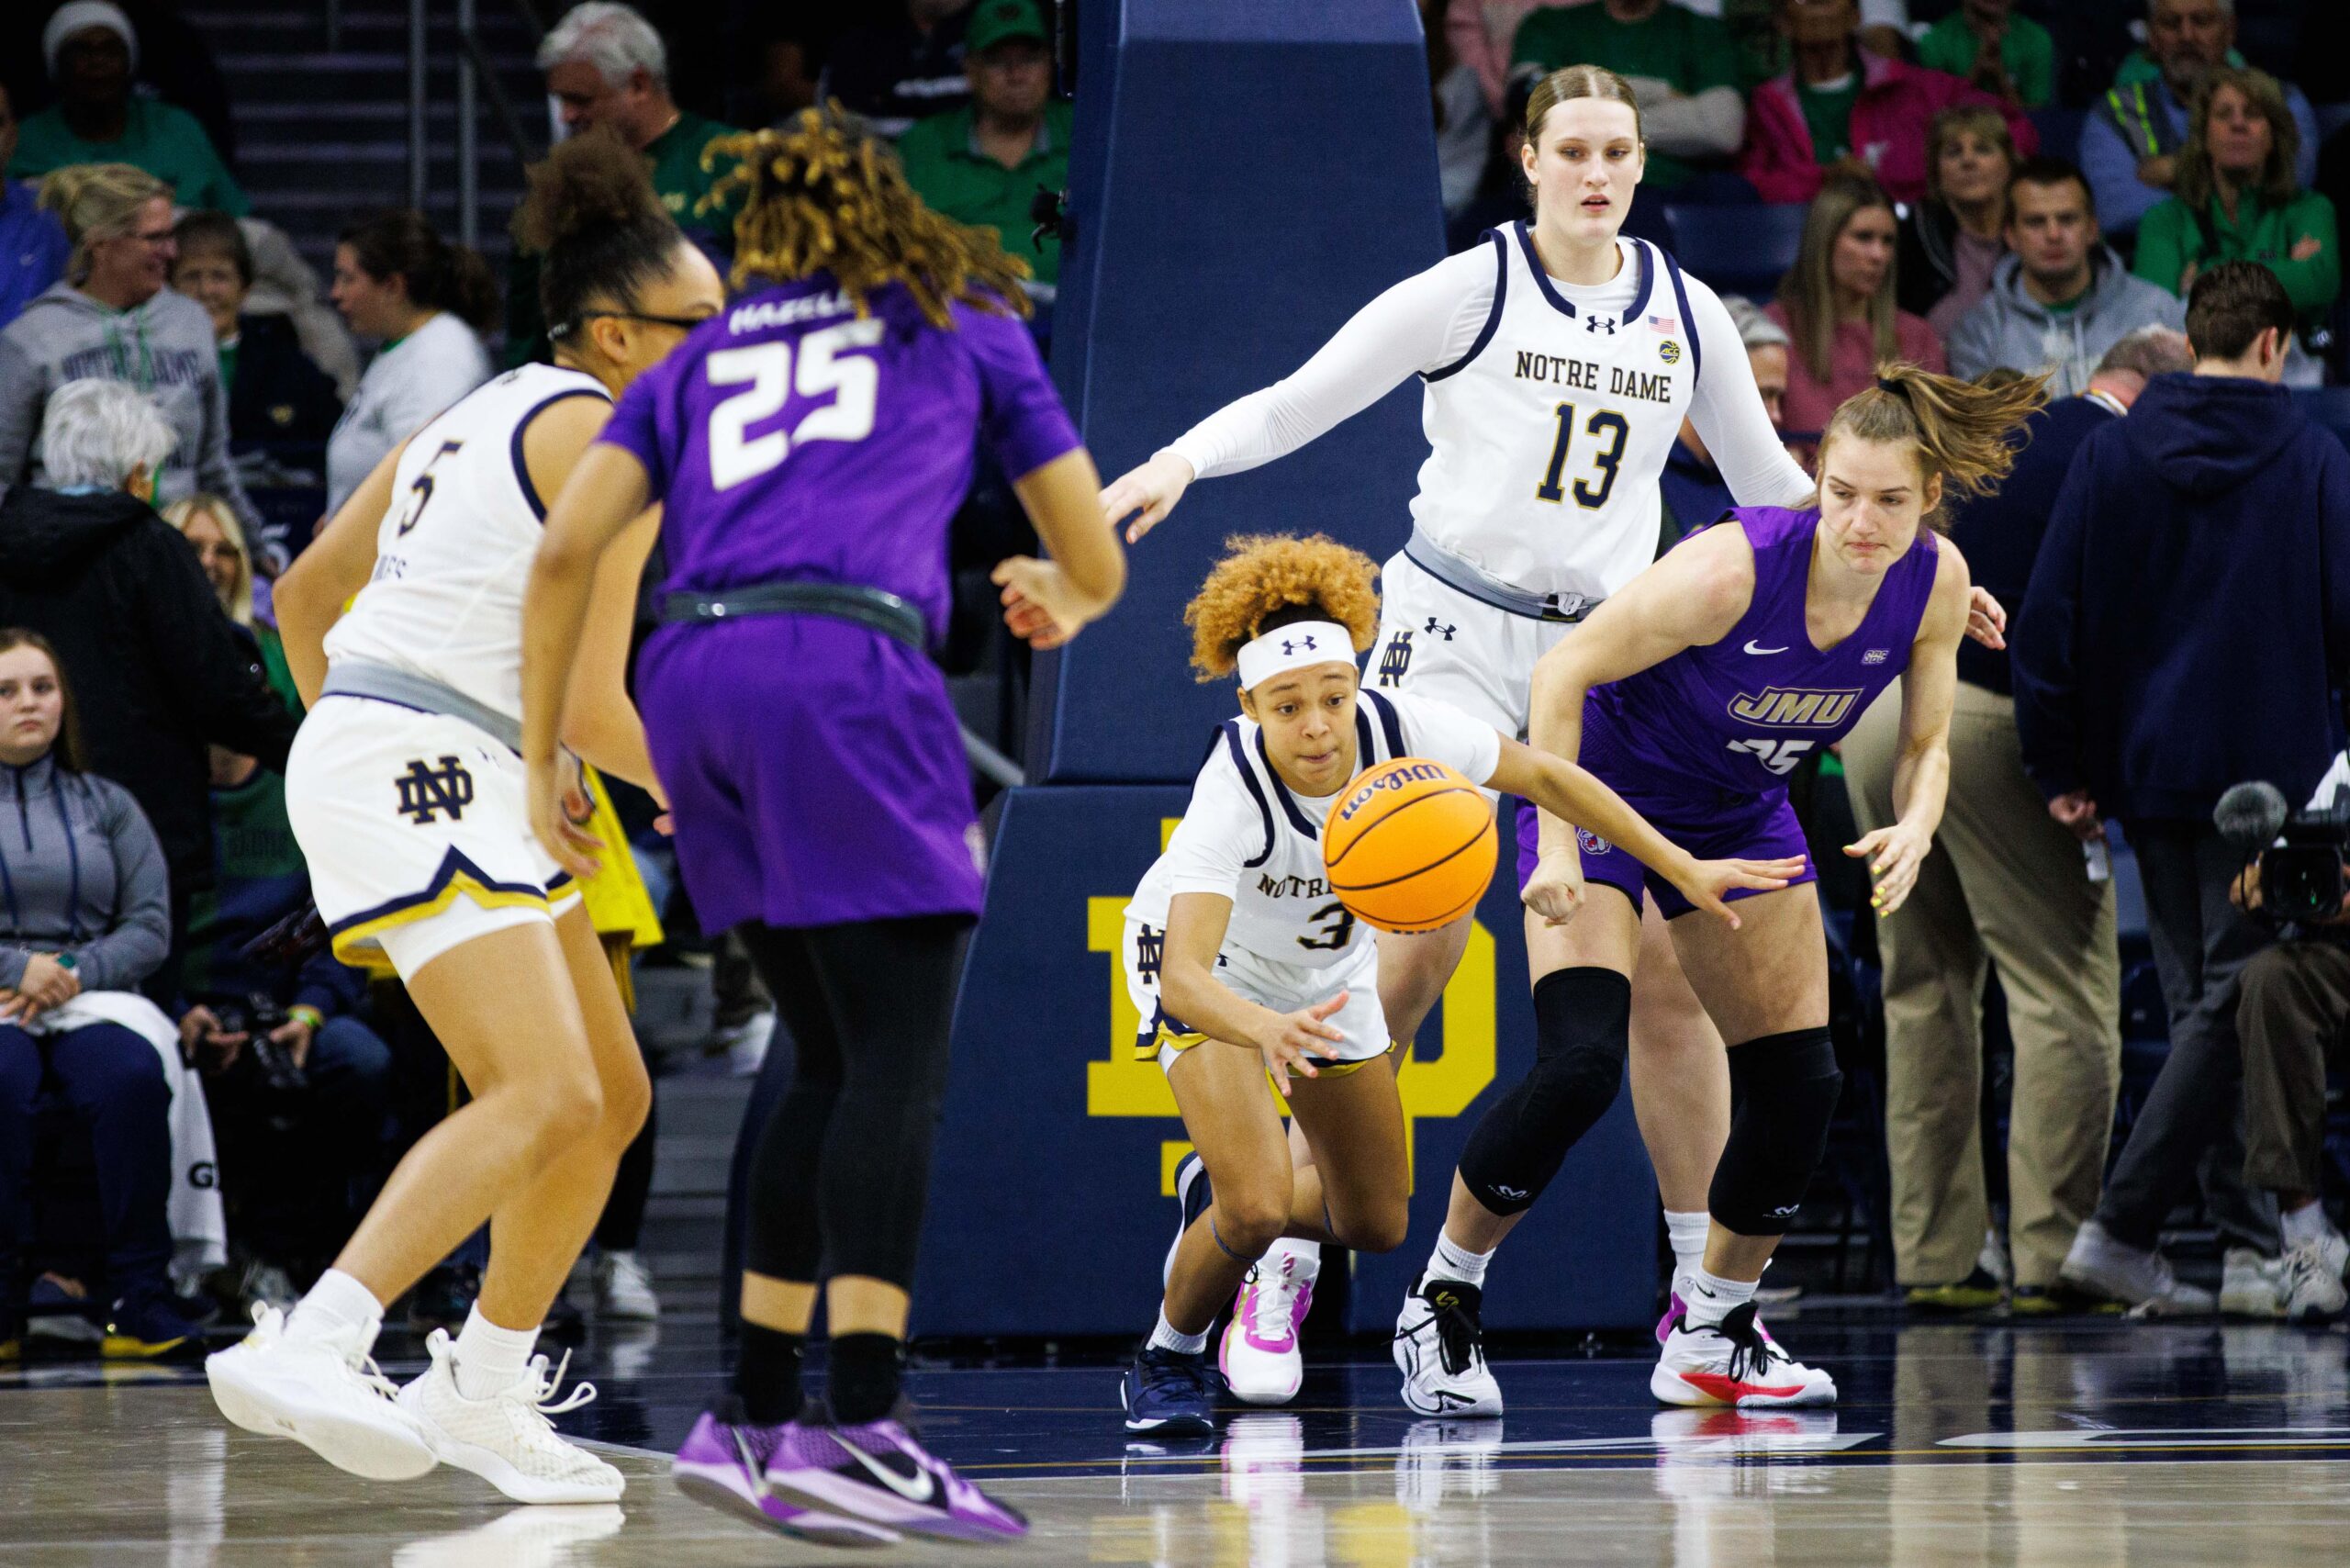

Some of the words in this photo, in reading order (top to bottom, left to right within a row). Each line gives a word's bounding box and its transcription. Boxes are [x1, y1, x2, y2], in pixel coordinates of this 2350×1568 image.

[706, 318, 885, 491] 25
[1515, 350, 1600, 391] NOTRE
[1609, 366, 1673, 404] DAME
[1535, 400, 1631, 511] 13
[397, 439, 466, 539] 5
[1732, 690, 1857, 723] JMU
[1339, 763, 1449, 822] Wilson
[1256, 872, 1335, 900] NOTR
[1295, 901, 1356, 960] 3
